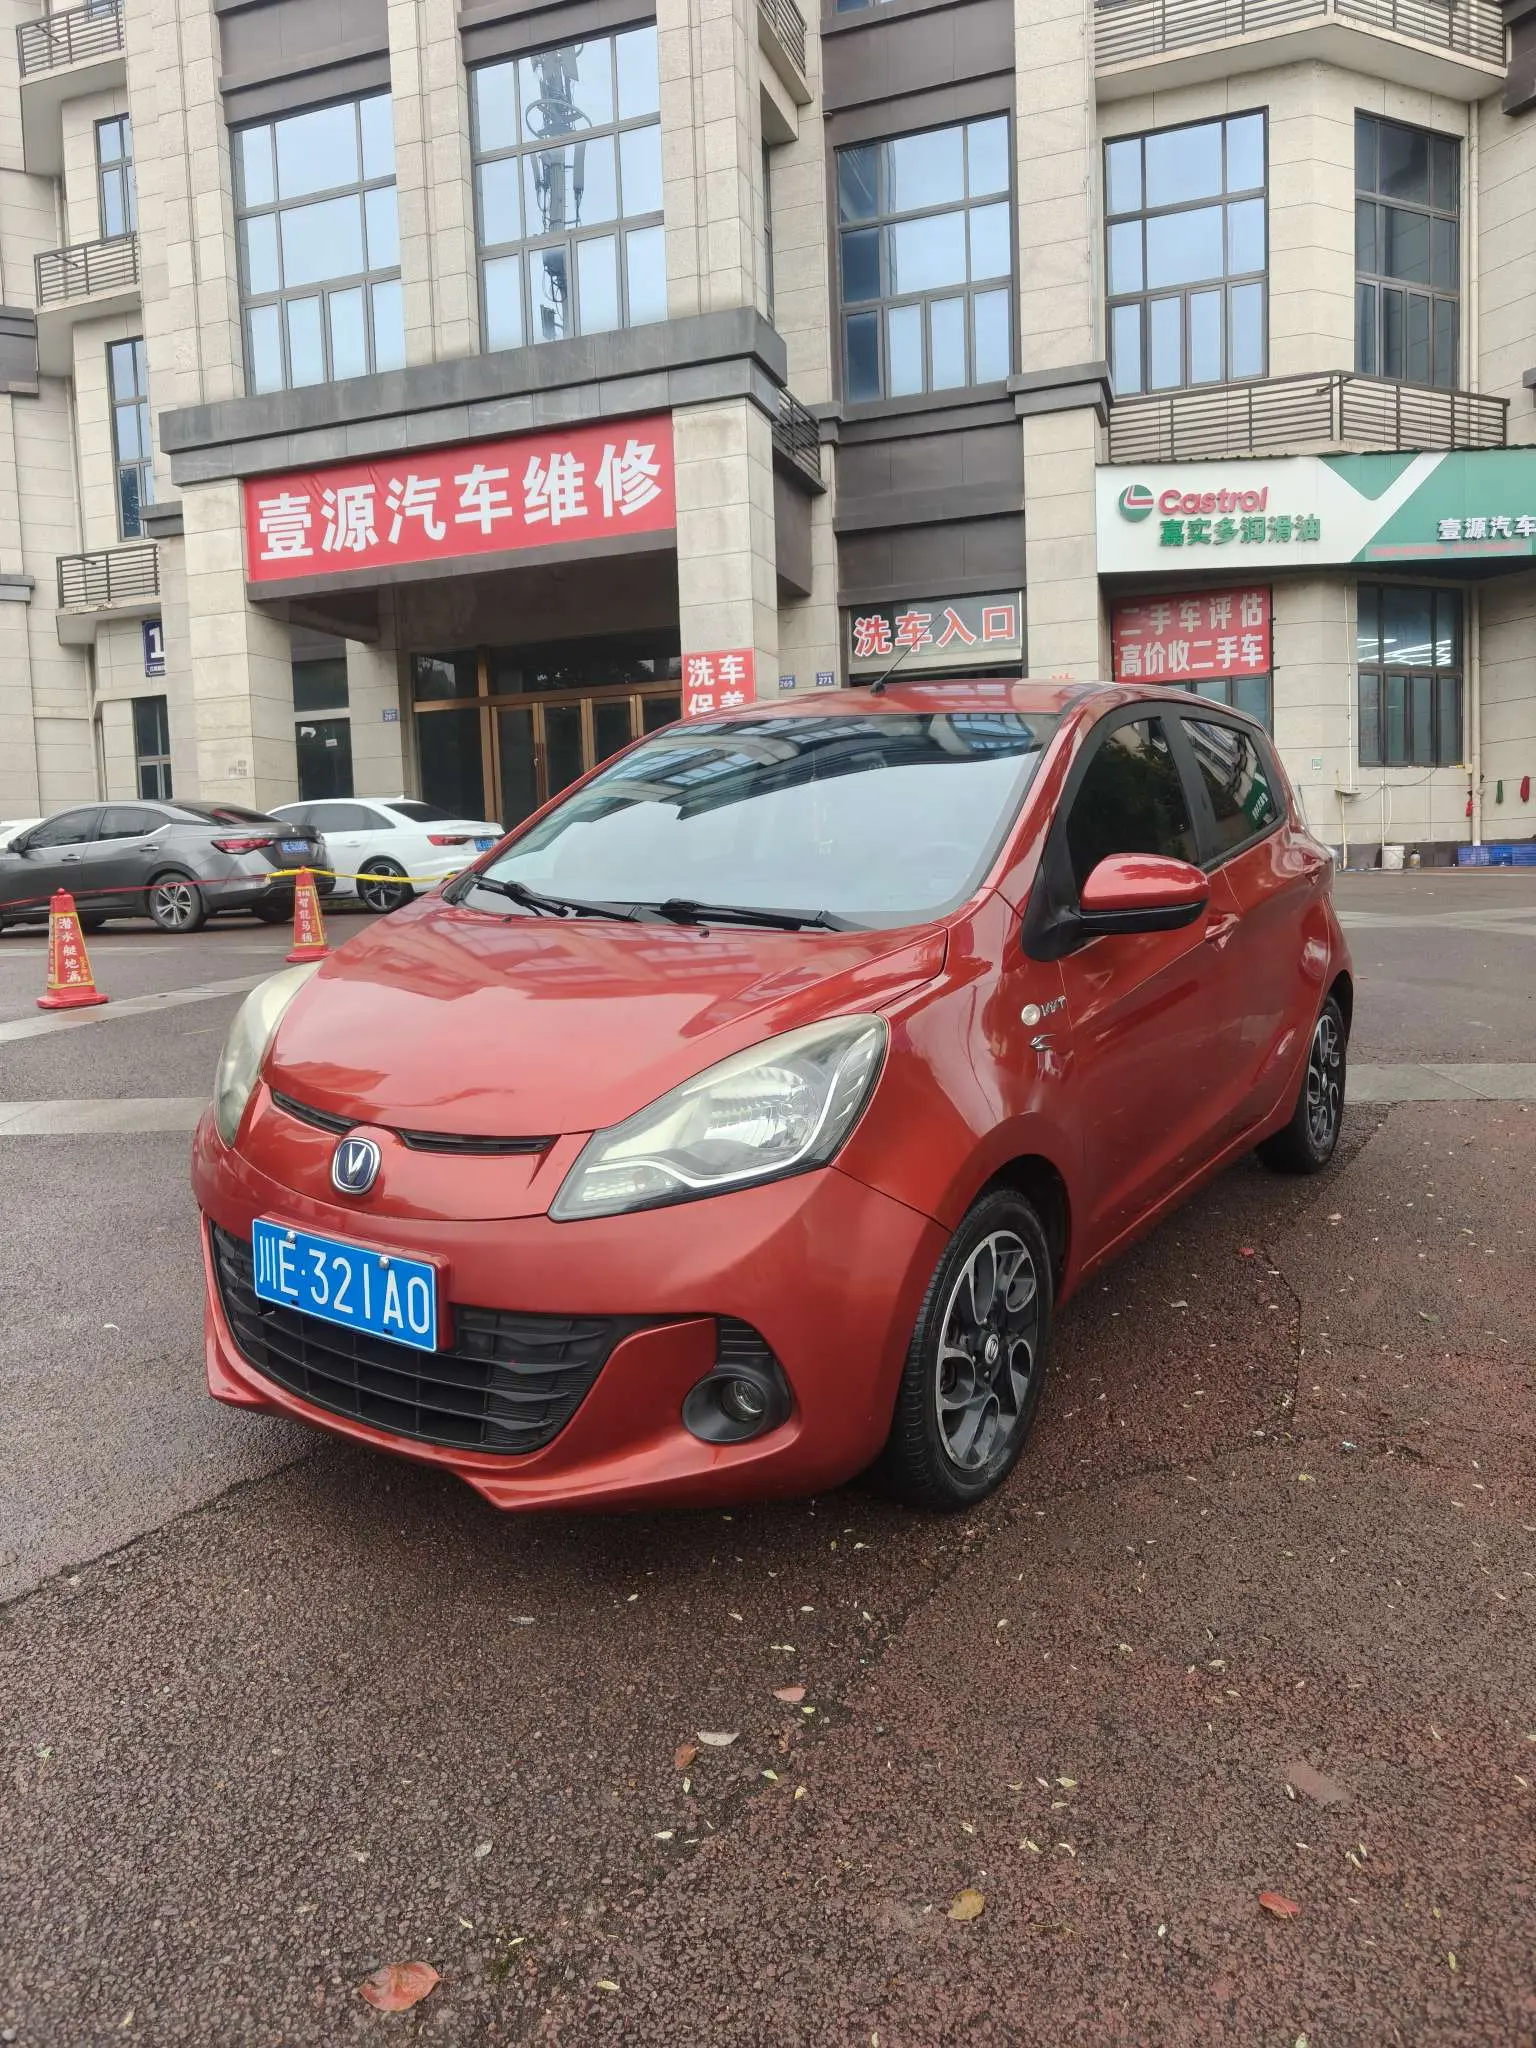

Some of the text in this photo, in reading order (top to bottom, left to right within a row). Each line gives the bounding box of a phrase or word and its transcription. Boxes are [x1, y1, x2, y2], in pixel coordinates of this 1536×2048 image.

[258, 439, 662, 561] 壹源汽车维修
[1158, 486, 1269, 515] Castrol
[1159, 513, 1321, 547] 嘉实多润滑油
[1437, 514, 1536, 541] 壹源汽车
[853, 605, 1016, 657] 洗车入口
[1119, 593, 1264, 636] 二手车评估
[687, 654, 746, 688] 洗车
[1119, 633, 1264, 678] 高价收二手车
[259, 1235, 430, 1335] 川E·321A0
